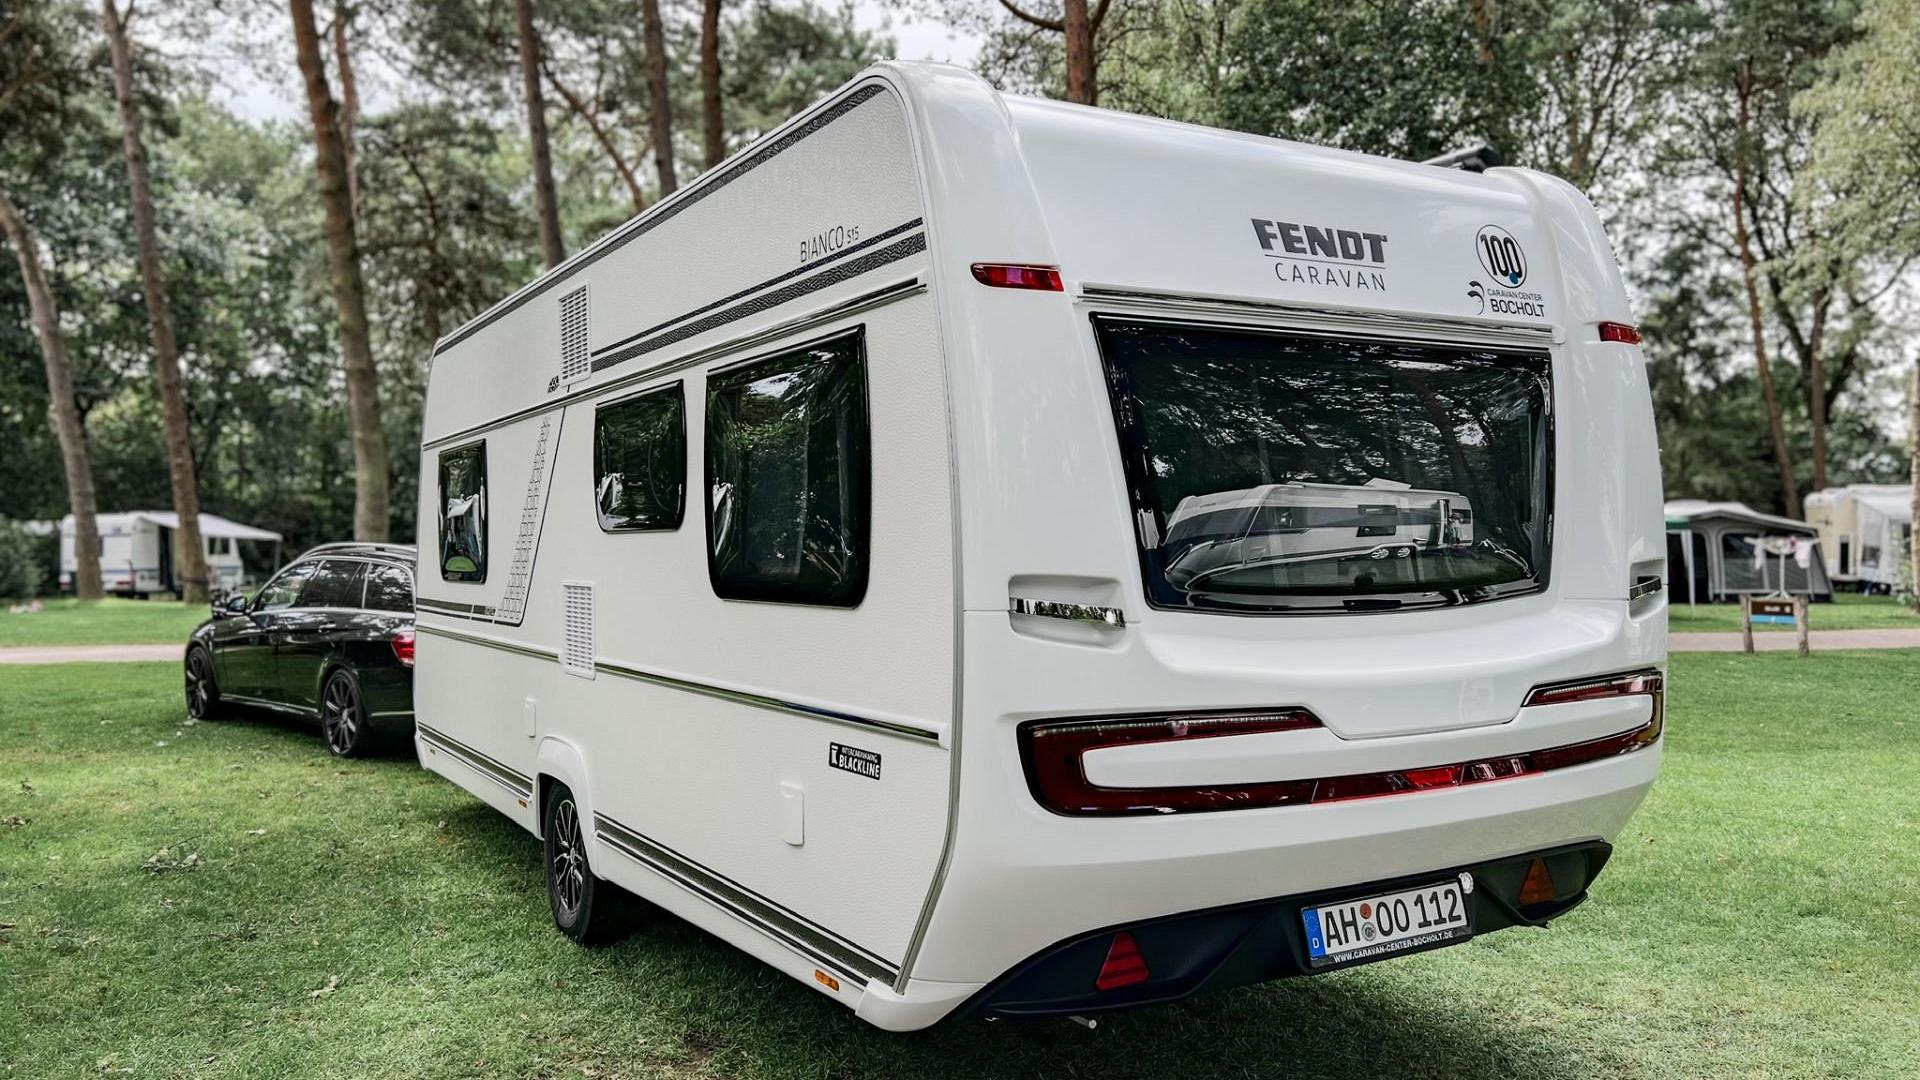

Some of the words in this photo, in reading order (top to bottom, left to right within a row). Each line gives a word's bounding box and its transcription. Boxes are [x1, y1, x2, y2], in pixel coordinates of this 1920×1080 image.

[800, 225, 844, 263] BIANCO
[847, 226, 859, 244] 515
[1251, 218, 1387, 263] FENDT
[1480, 234, 1523, 278] 100
[1275, 262, 1386, 291] CARAVAN
[1487, 289, 1517, 298] CARAVAN
[1490, 298, 1545, 317] BOCHOLT
[839, 754, 880, 778] BLACKLINE
[1325, 907, 1360, 948] AH
[1414, 888, 1462, 928] 112
[1312, 937, 1320, 949] D
[1333, 930, 1454, 964] WWW.CARAVAN-CENTER-BOCHOLT.DE
